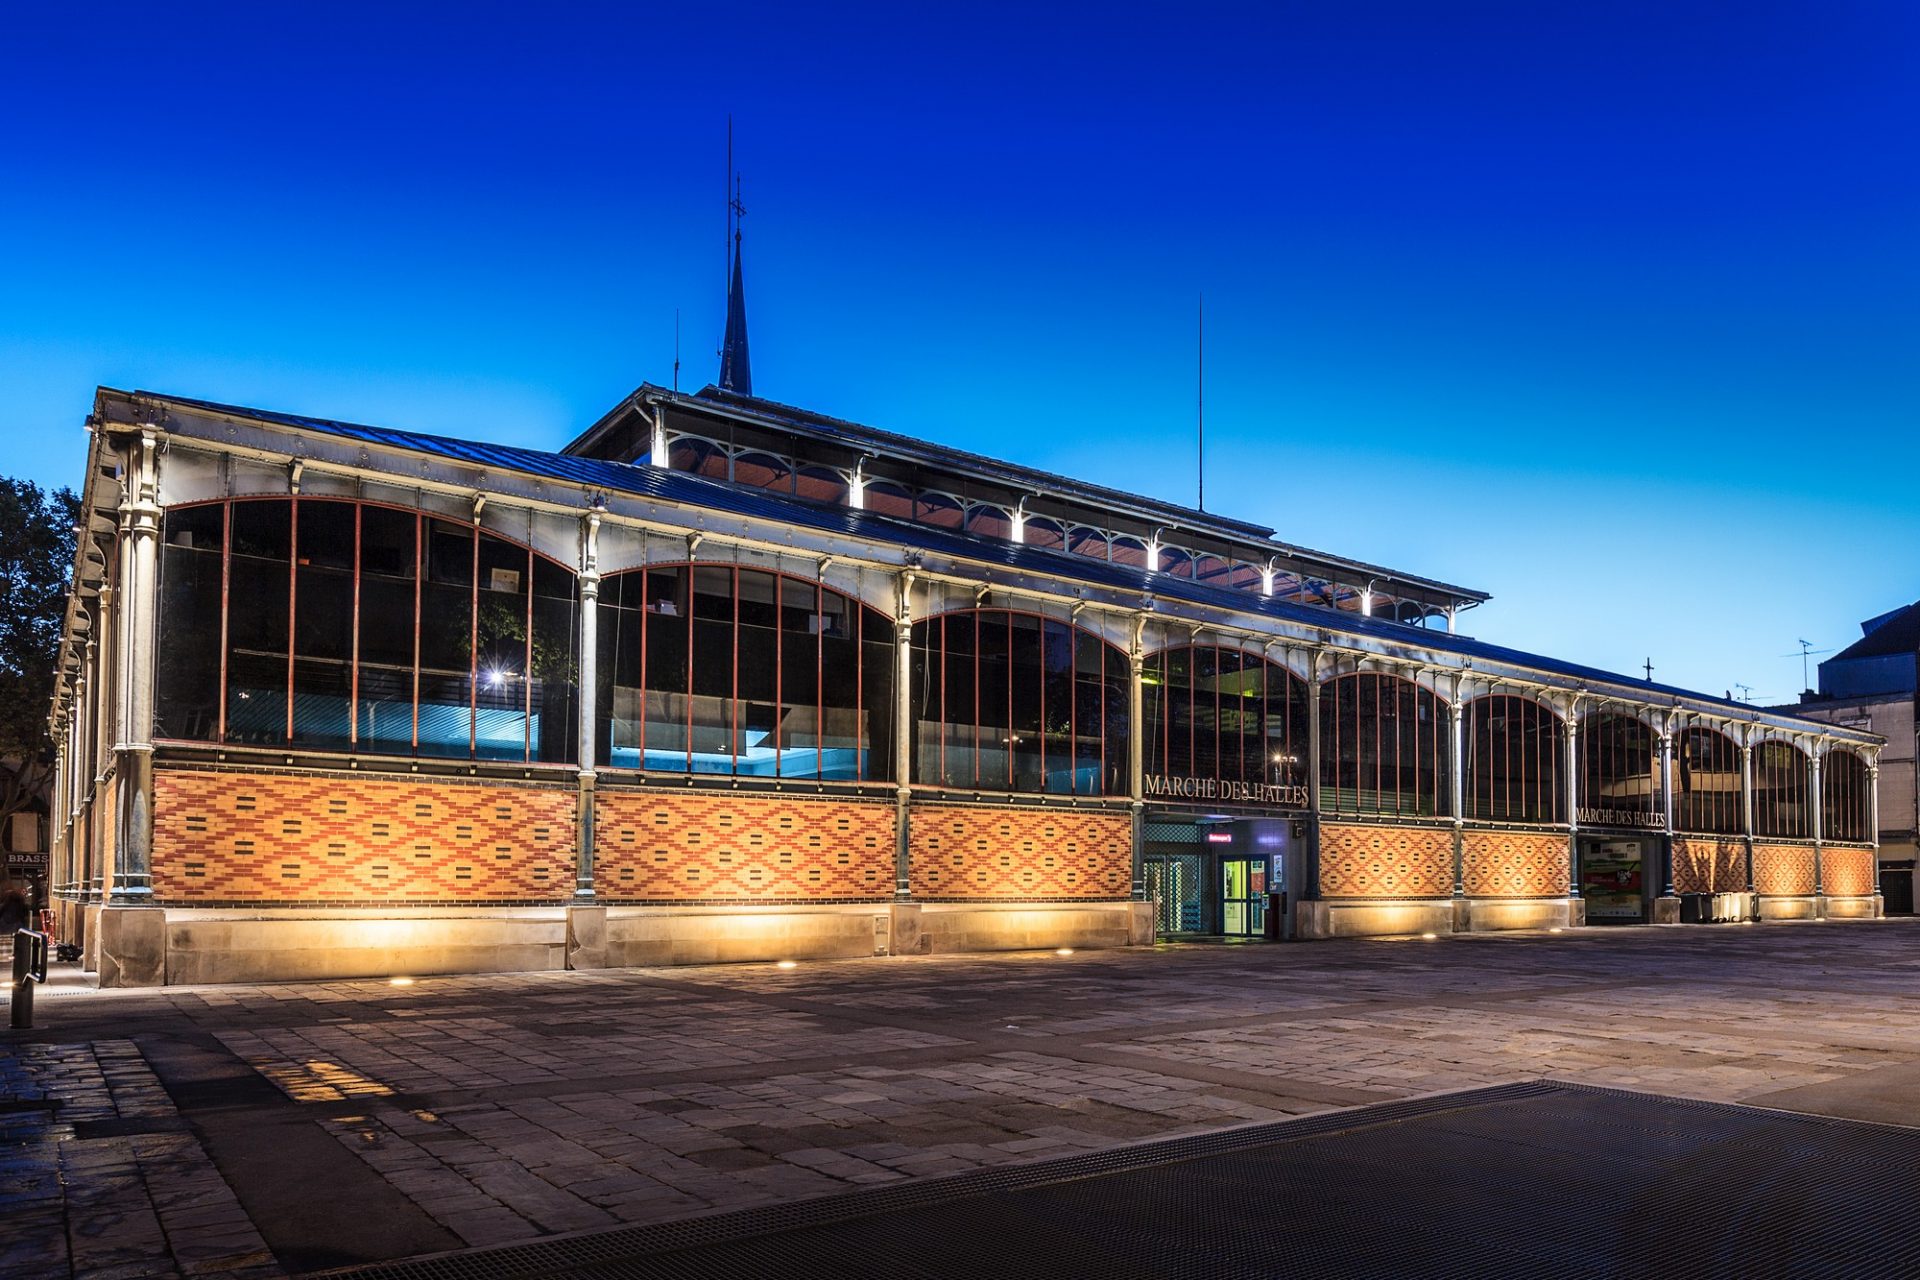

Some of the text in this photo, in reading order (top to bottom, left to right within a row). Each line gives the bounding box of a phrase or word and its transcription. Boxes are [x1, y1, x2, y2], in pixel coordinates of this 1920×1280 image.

[1145, 774, 1309, 804] MARCHÉ DES HALLES
[1616, 810, 1632, 825] DES
[1634, 812, 1665, 827] HALLES
